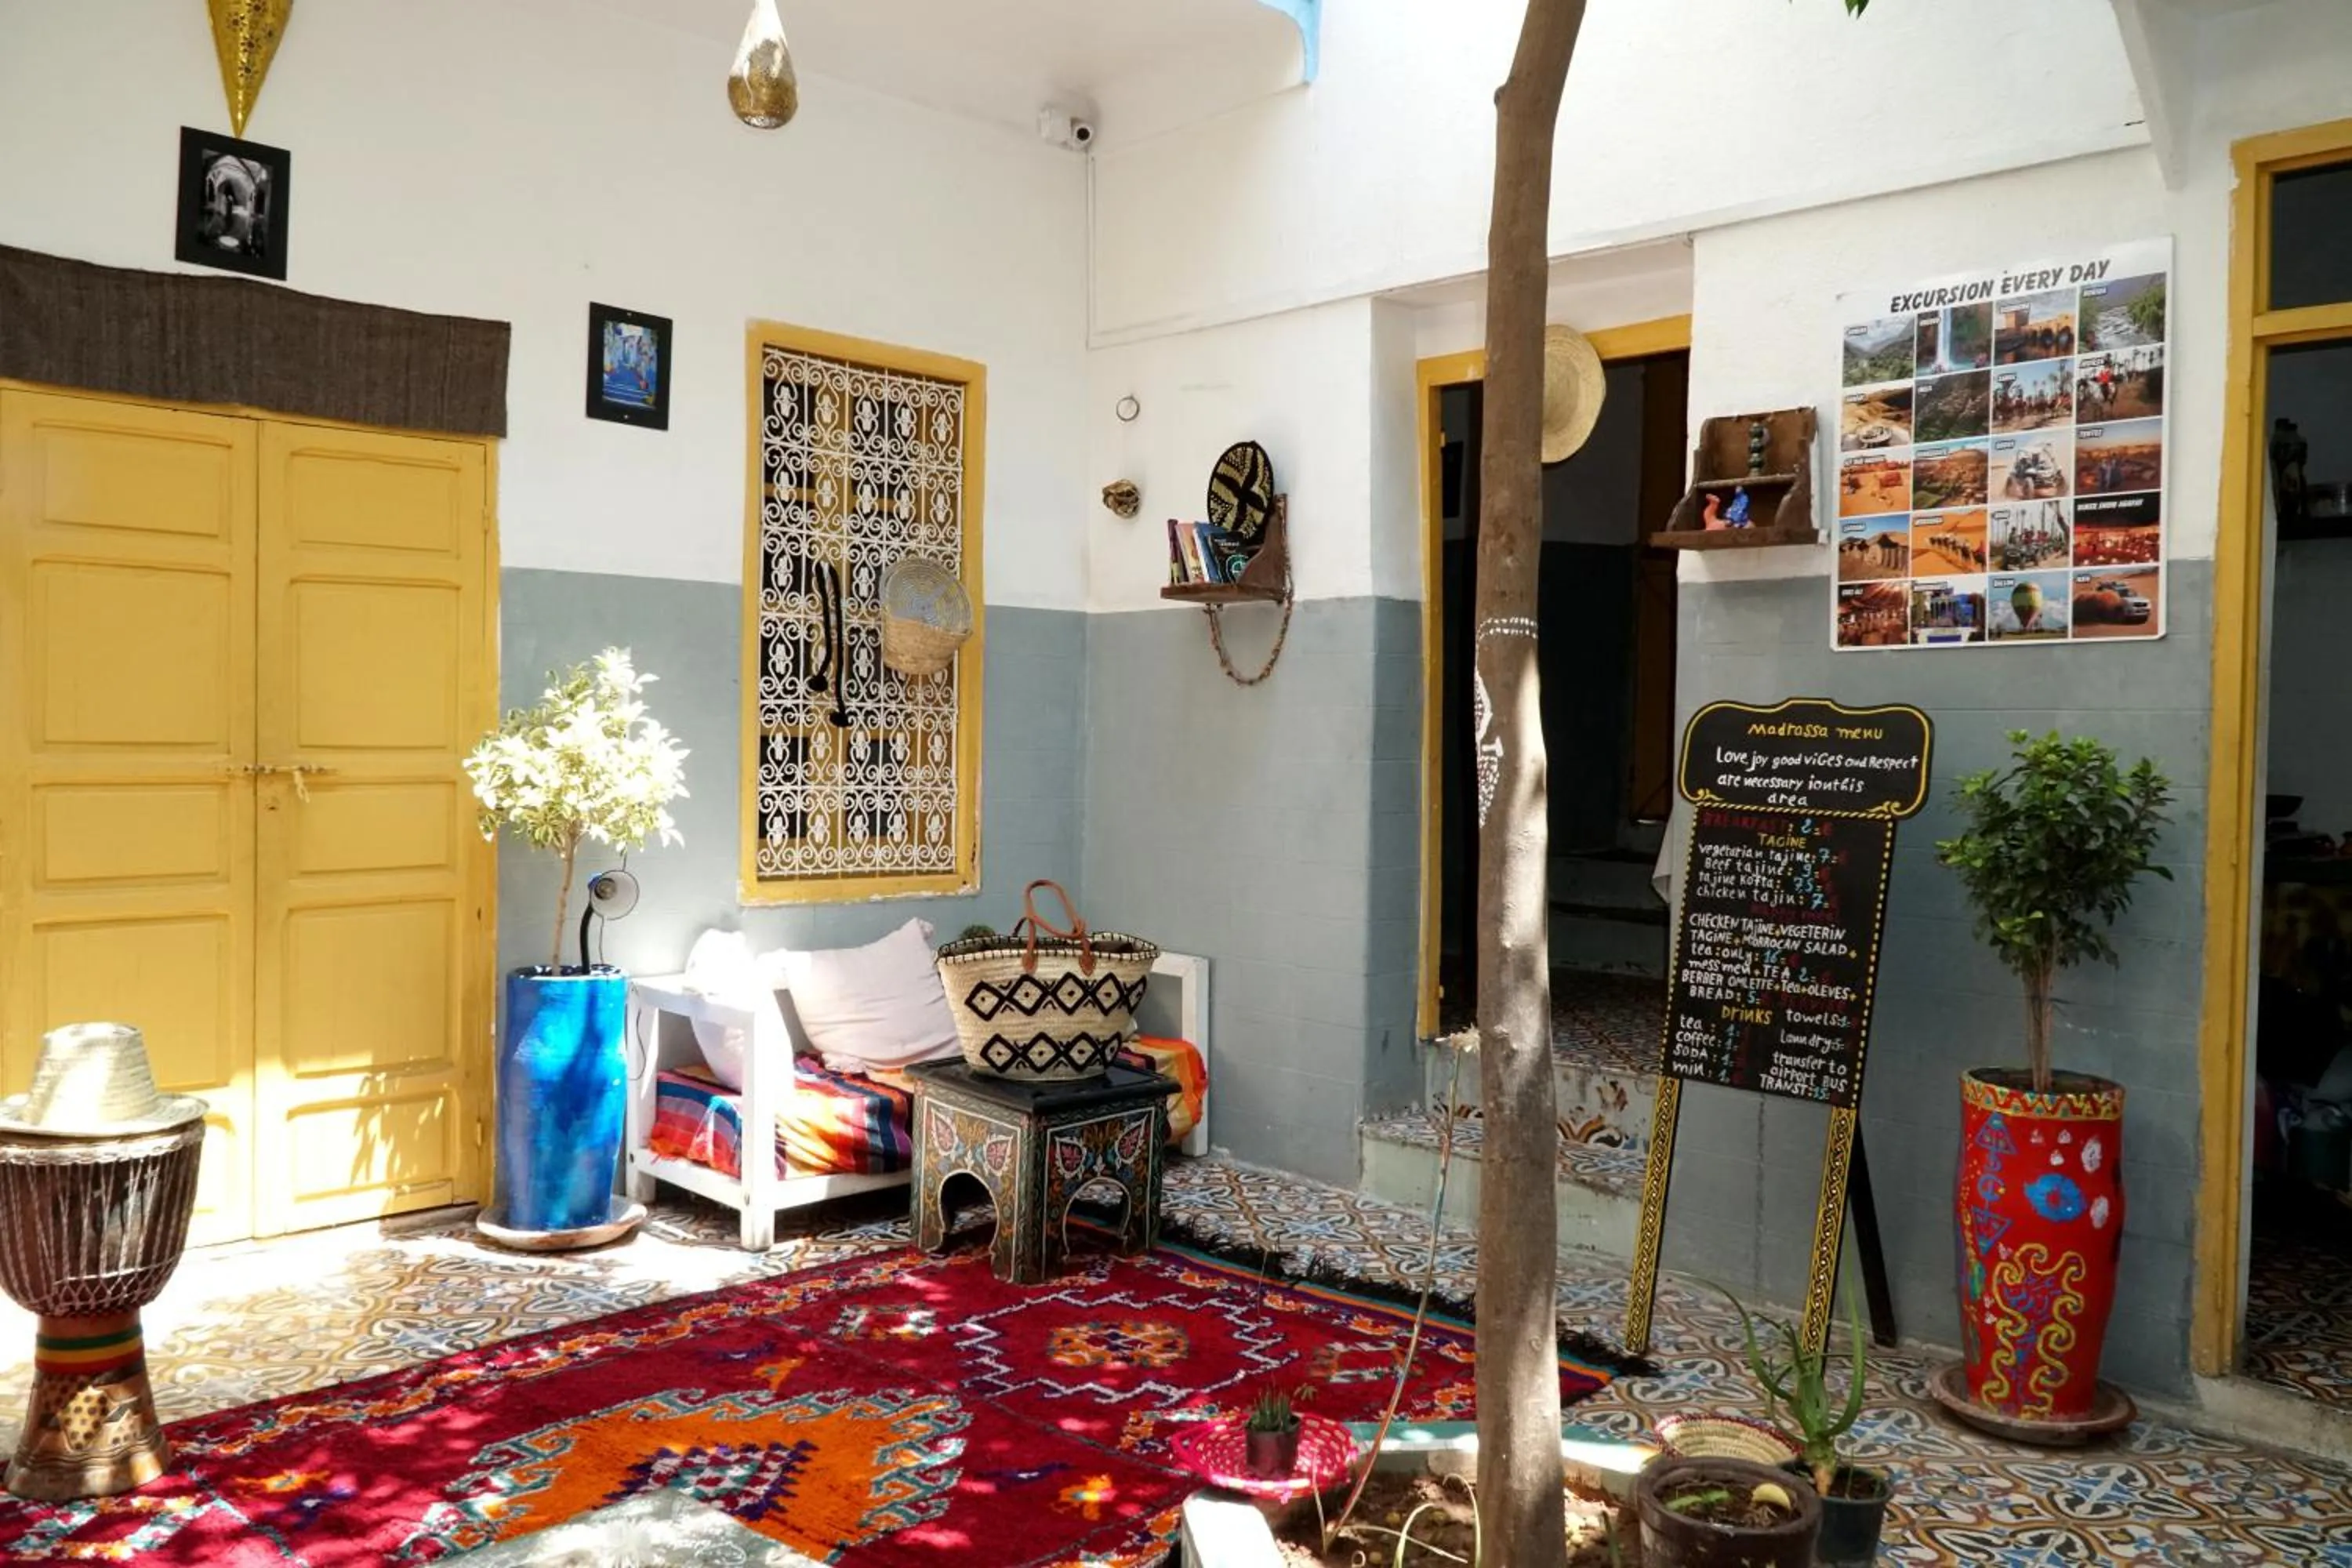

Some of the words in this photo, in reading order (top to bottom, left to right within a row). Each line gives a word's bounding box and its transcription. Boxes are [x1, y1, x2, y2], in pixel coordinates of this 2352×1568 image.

[1889, 278, 1994, 314] EXCURSION
[2000, 267, 2063, 295] EVERY
[2069, 258, 2111, 284] DAY
[1835, 727, 1882, 739] menu
[1745, 750, 1769, 772] joy
[1771, 753, 1802, 769] good
[1716, 773, 1742, 787] are
[1767, 793, 1809, 806] area
[1804, 941, 1848, 955] SALAD
[1762, 964, 1791, 979] TEA
[1828, 1059, 1847, 1076] to
[1823, 1075, 1848, 1093] BUS
